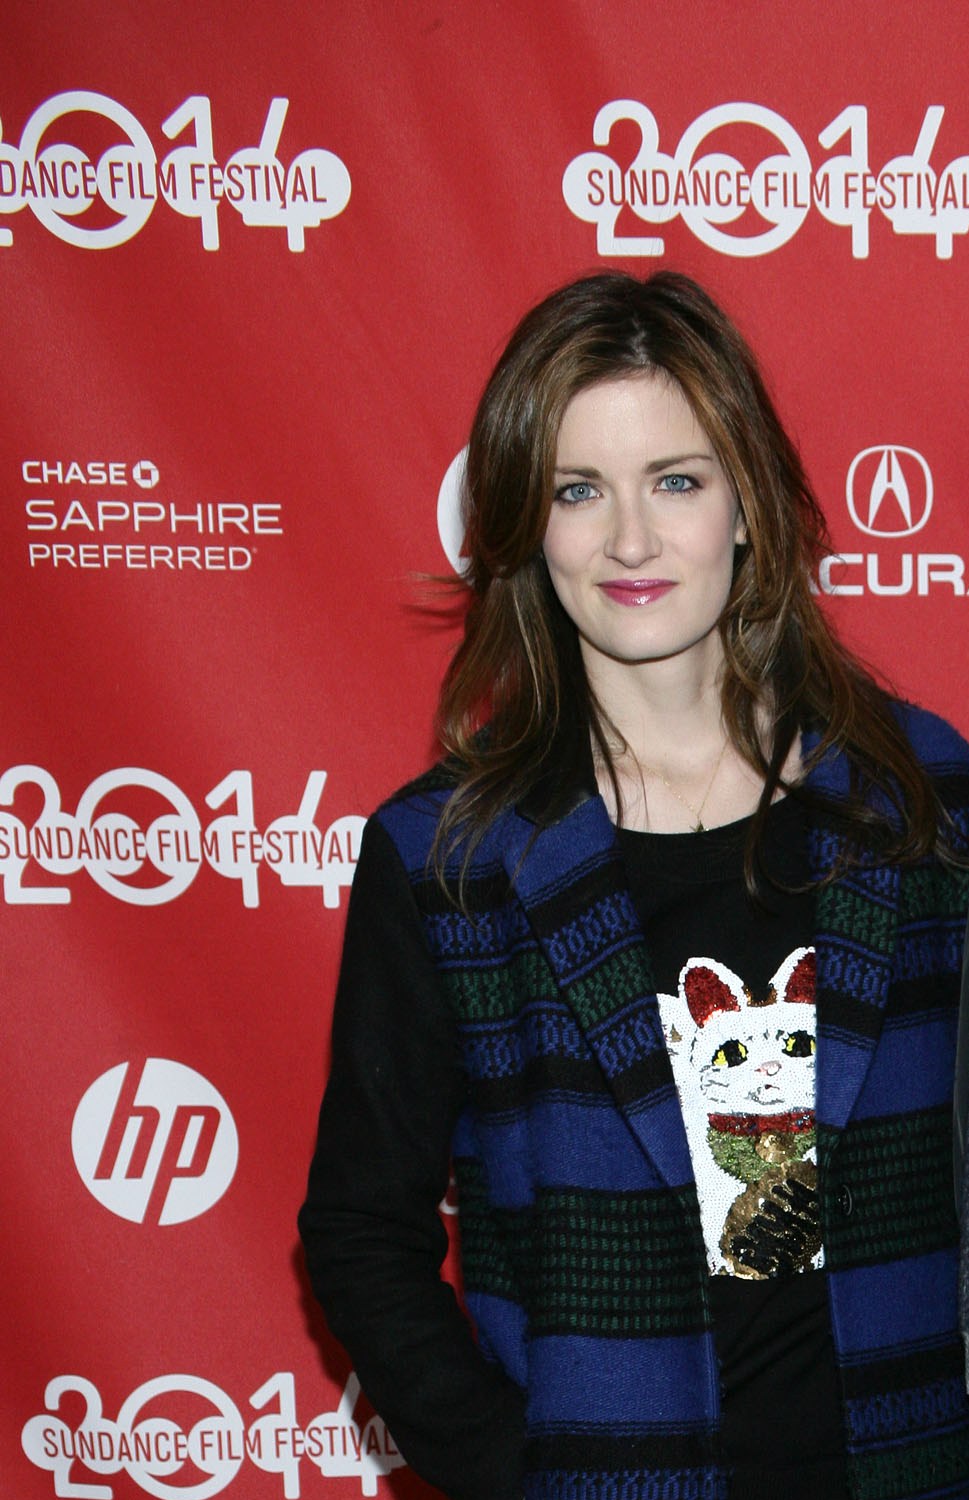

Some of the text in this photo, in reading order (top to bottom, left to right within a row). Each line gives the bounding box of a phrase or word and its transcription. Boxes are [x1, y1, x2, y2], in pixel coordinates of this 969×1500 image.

[0, 90, 321, 252] 014
[0, 160, 327, 204] DANCE FILM FESTIVAL
[587, 169, 750, 206] SUNDANCE
[763, 171, 830, 208] FILM
[593, 100, 969, 259] 2014
[22, 461, 128, 485] CHASE
[26, 500, 283, 534] SAPPHIRE
[29, 544, 251, 570] PREFERRED
[0, 764, 355, 908] 2014
[0, 826, 359, 865] SUNDANCE FILM FESTIVAL
[93, 1057, 222, 1225] hp
[44, 1426, 397, 1461] SUNDANCE FILM FESTIVAL
